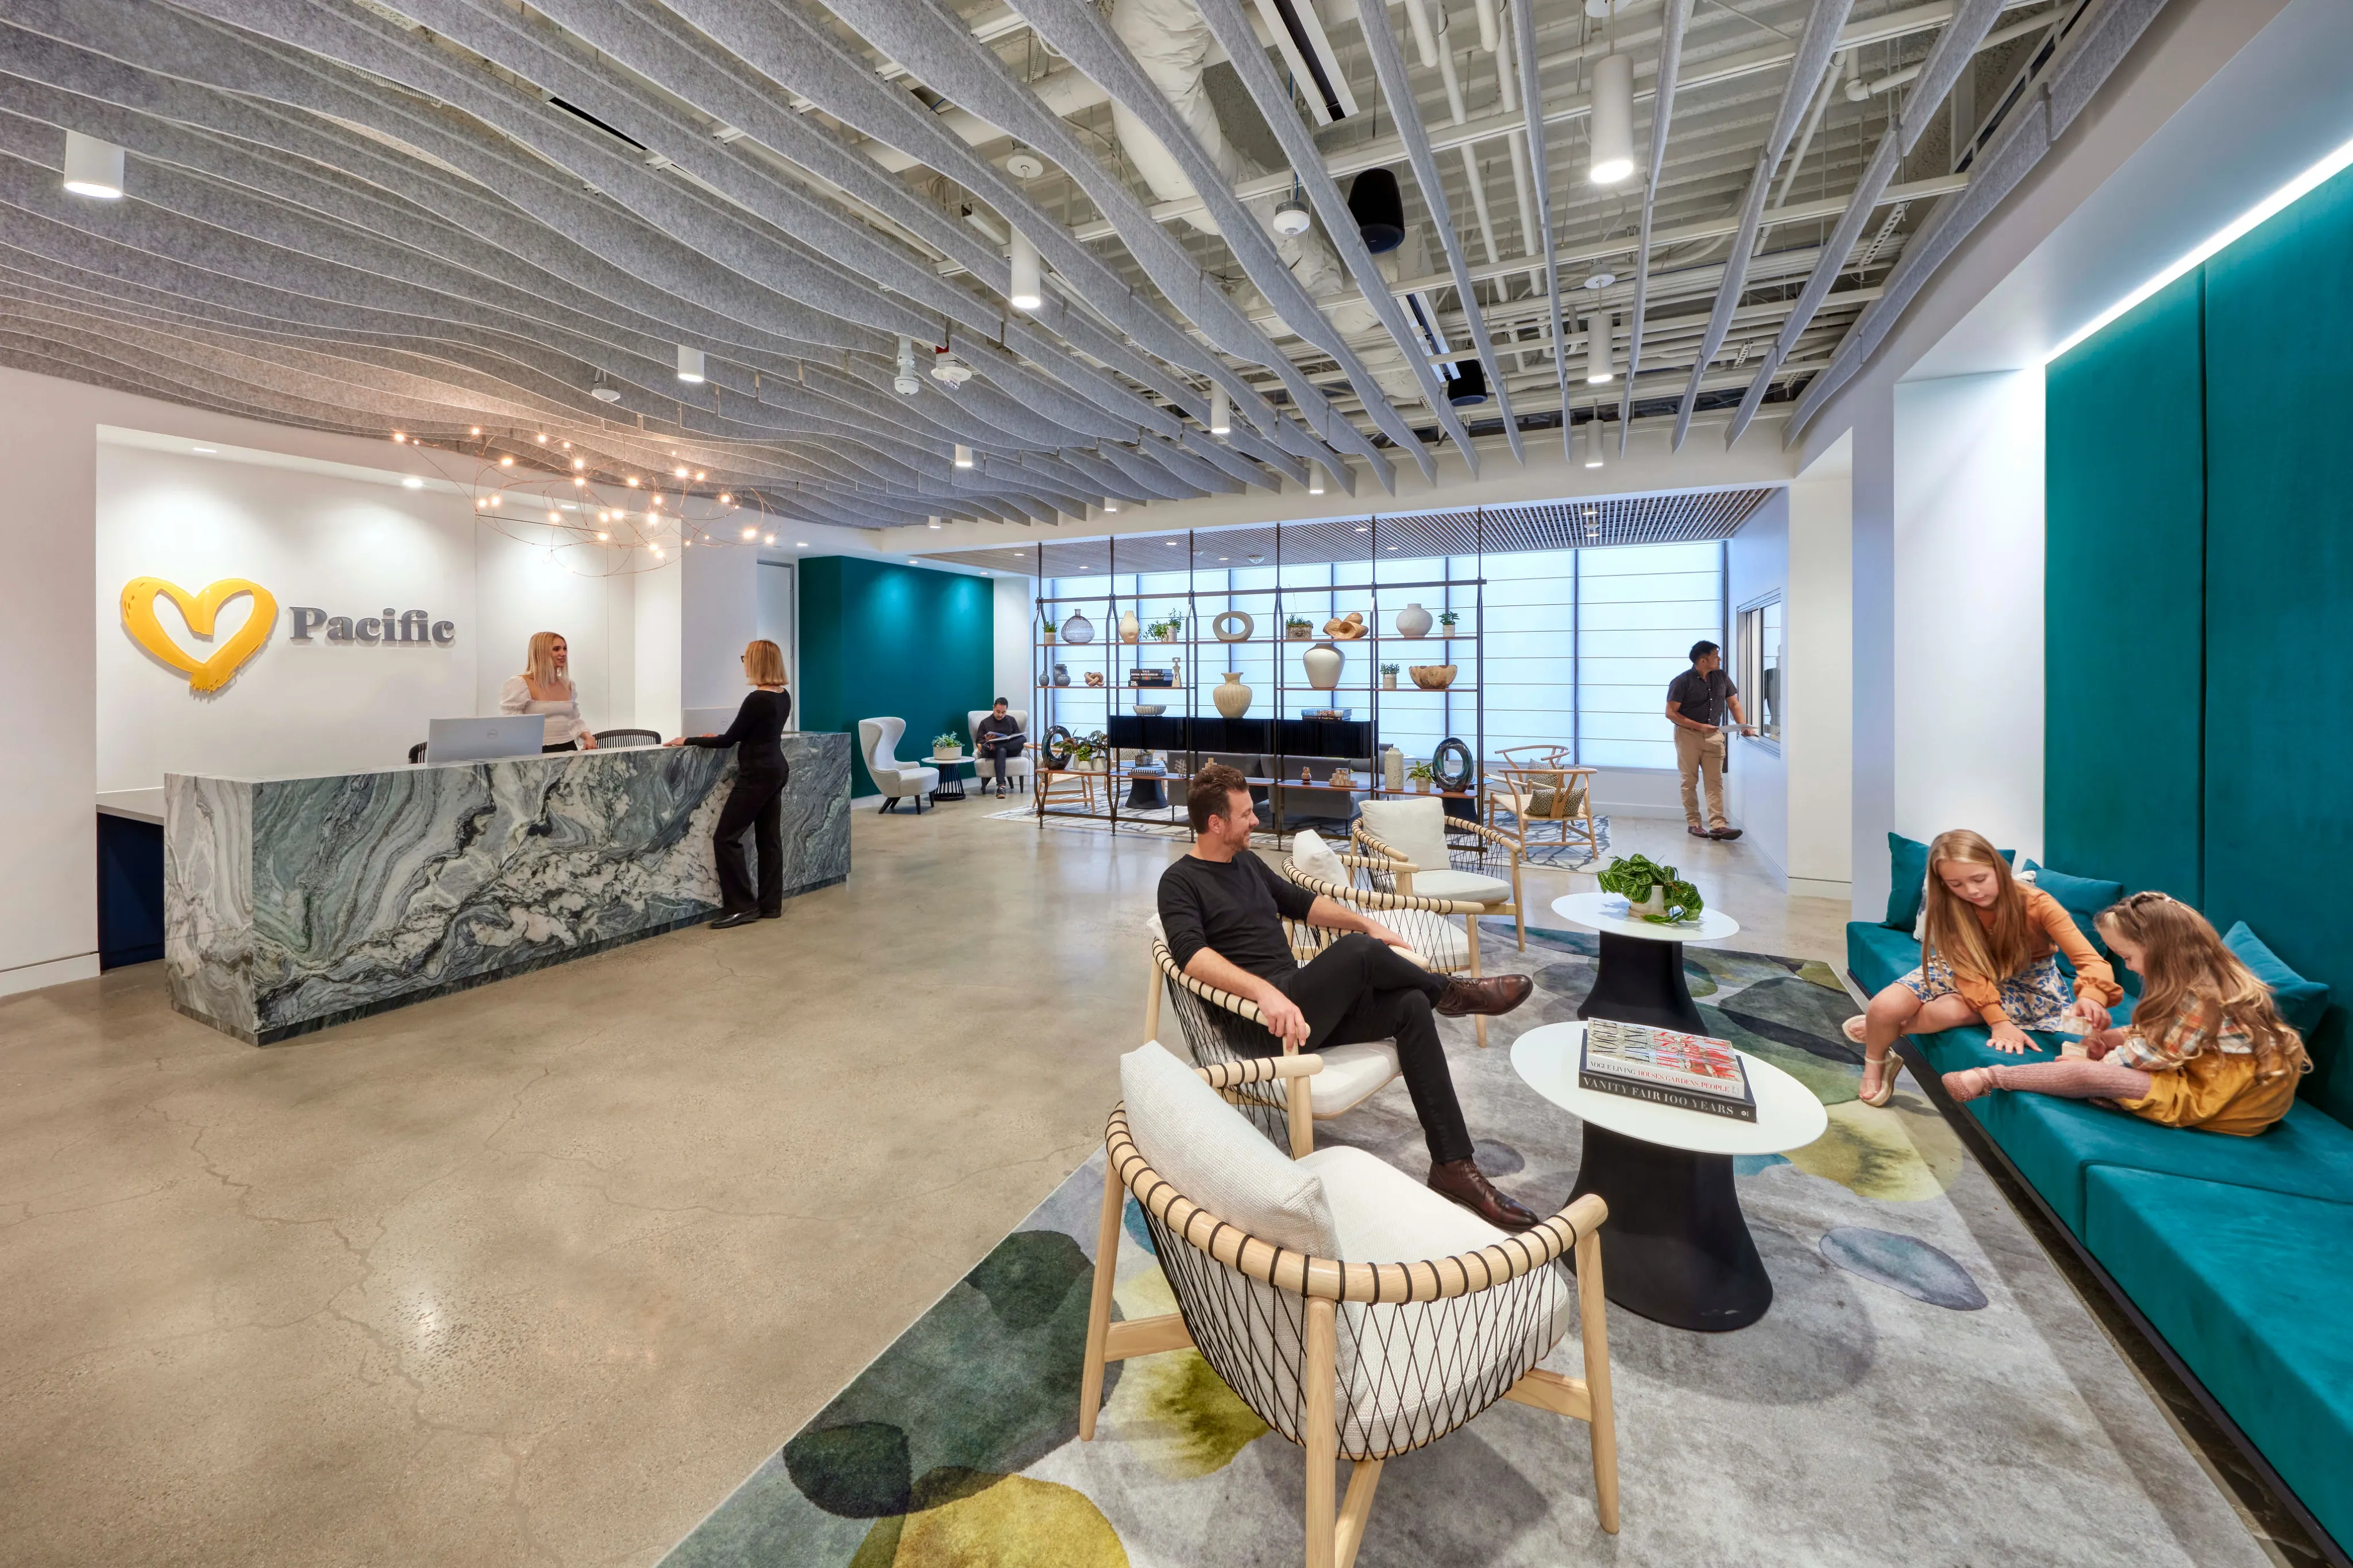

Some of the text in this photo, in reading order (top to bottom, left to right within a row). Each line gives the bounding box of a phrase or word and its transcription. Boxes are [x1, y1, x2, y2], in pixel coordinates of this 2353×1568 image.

[289, 606, 454, 642] Pacific
[1592, 1020, 1618, 1053] VOGUE
[1623, 1025, 1650, 1062] LIVING
[1654, 1031, 1680, 1068] HOUSES
[1591, 1061, 1611, 1071] VOGUE
[1613, 1065, 1635, 1075] LIVING
[1701, 1082, 1729, 1092] PEOPLE
[1584, 1077, 1628, 1094] VANITY
[1632, 1087, 1661, 1100] FAIR
[1665, 1094, 1687, 1106] 100
[1692, 1099, 1733, 1115] YEARS
